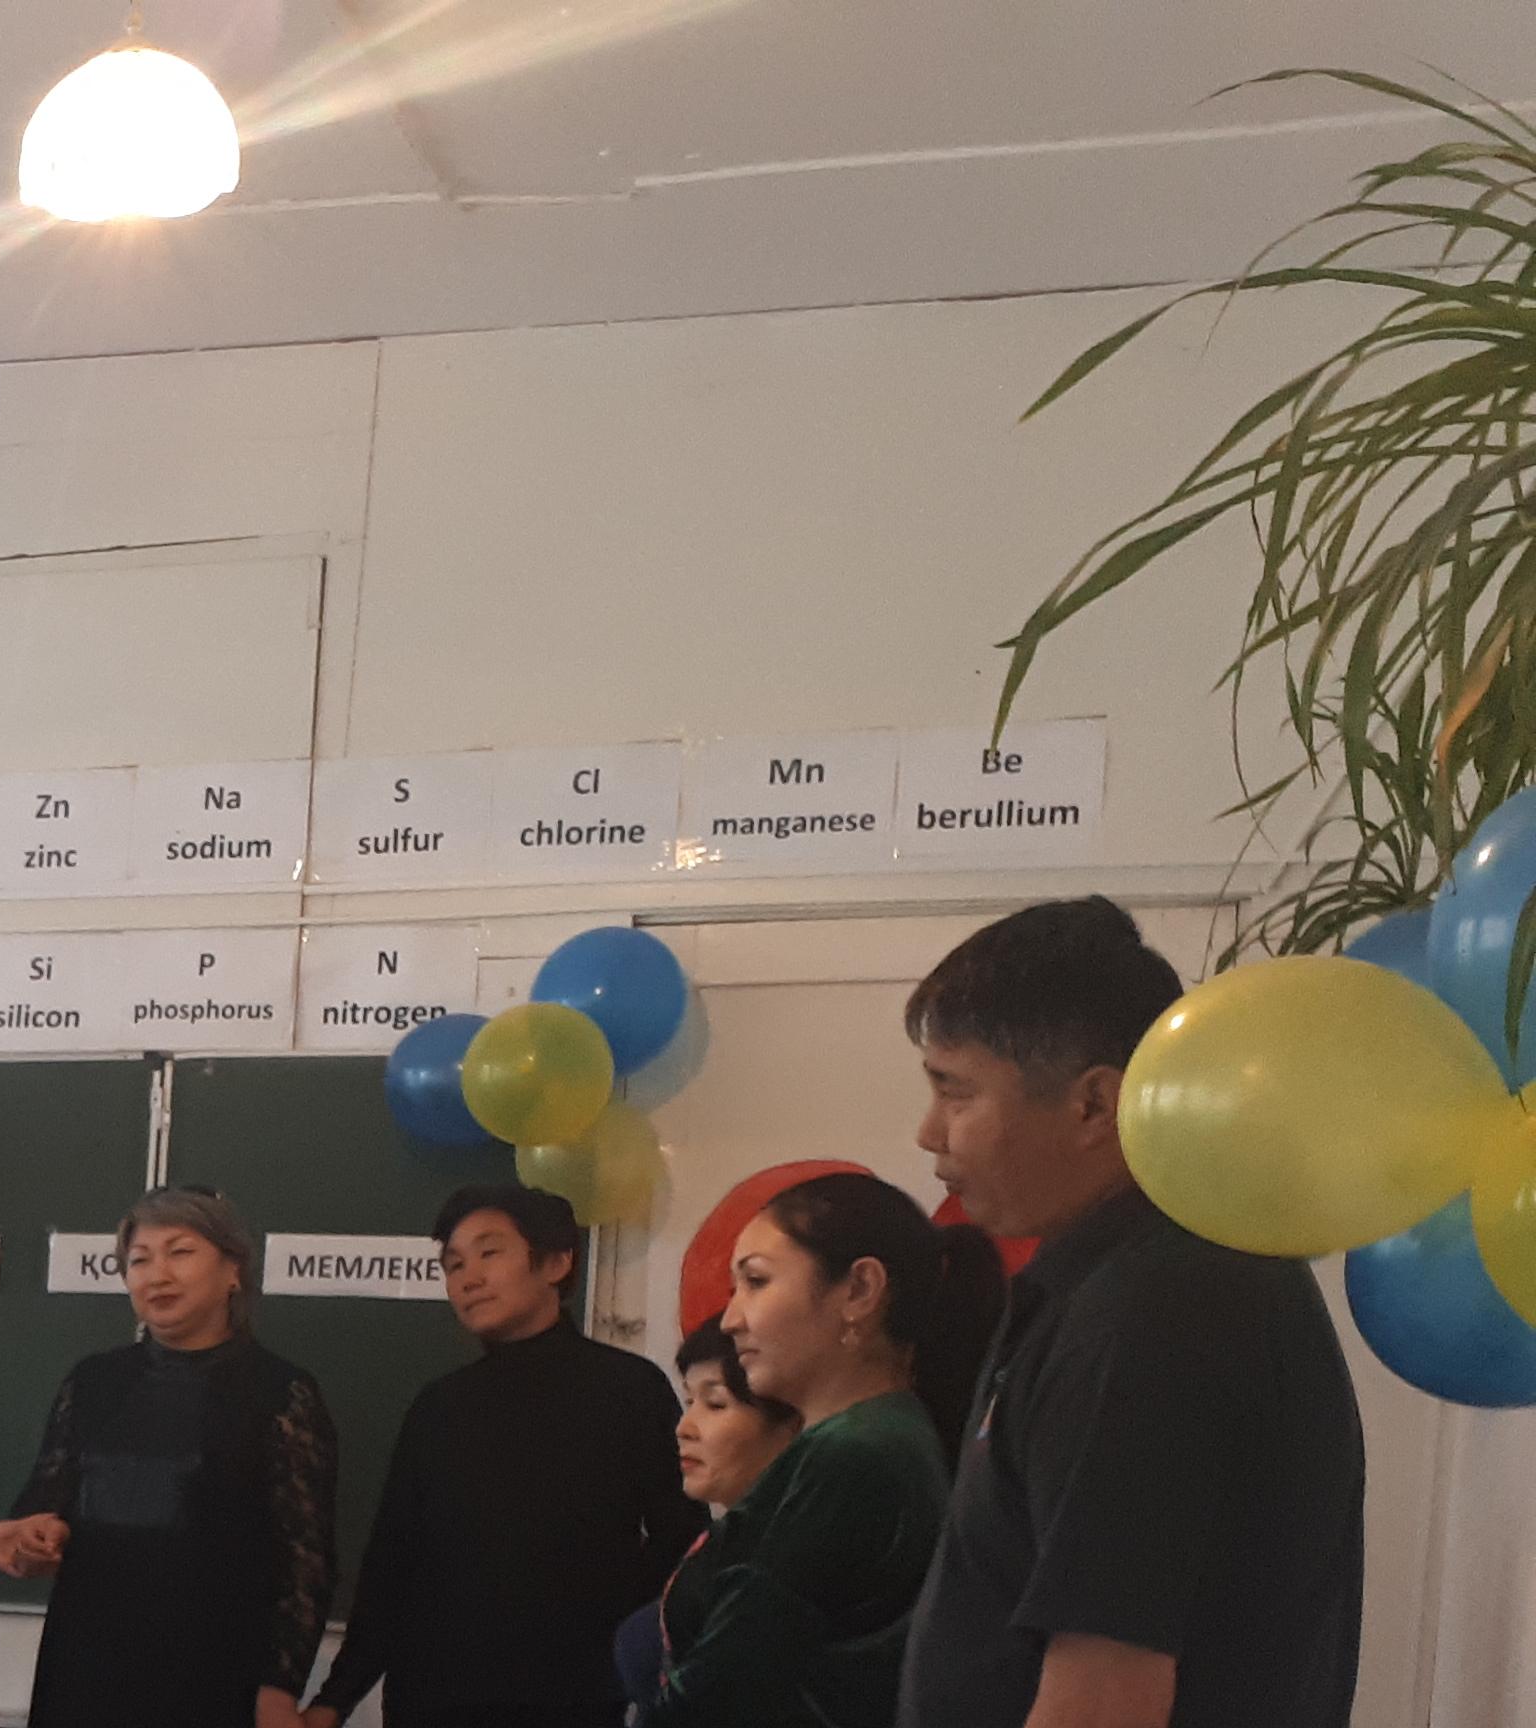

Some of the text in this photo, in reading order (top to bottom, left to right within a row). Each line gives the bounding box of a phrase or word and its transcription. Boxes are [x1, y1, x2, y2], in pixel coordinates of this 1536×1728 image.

[769, 758, 825, 785] Mn
[981, 748, 1023, 775] Be
[394, 778, 410, 803] S
[572, 768, 601, 795] Cl
[35, 794, 70, 819] Zn
[204, 786, 242, 810] Na
[712, 813, 876, 840] manganese
[917, 799, 1080, 830] berullium
[358, 826, 444, 855] sulfur
[520, 818, 646, 847] chlorine
[24, 844, 77, 869] zinc
[166, 834, 272, 861] sodium
[28, 956, 53, 981] Si
[198, 953, 216, 976] P
[377, 950, 398, 975] N
[134, 998, 274, 1025] phosphorus
[80, 1253, 121, 1281] ҚО
[288, 1254, 441, 1282] МЕМЛЕКЕ
